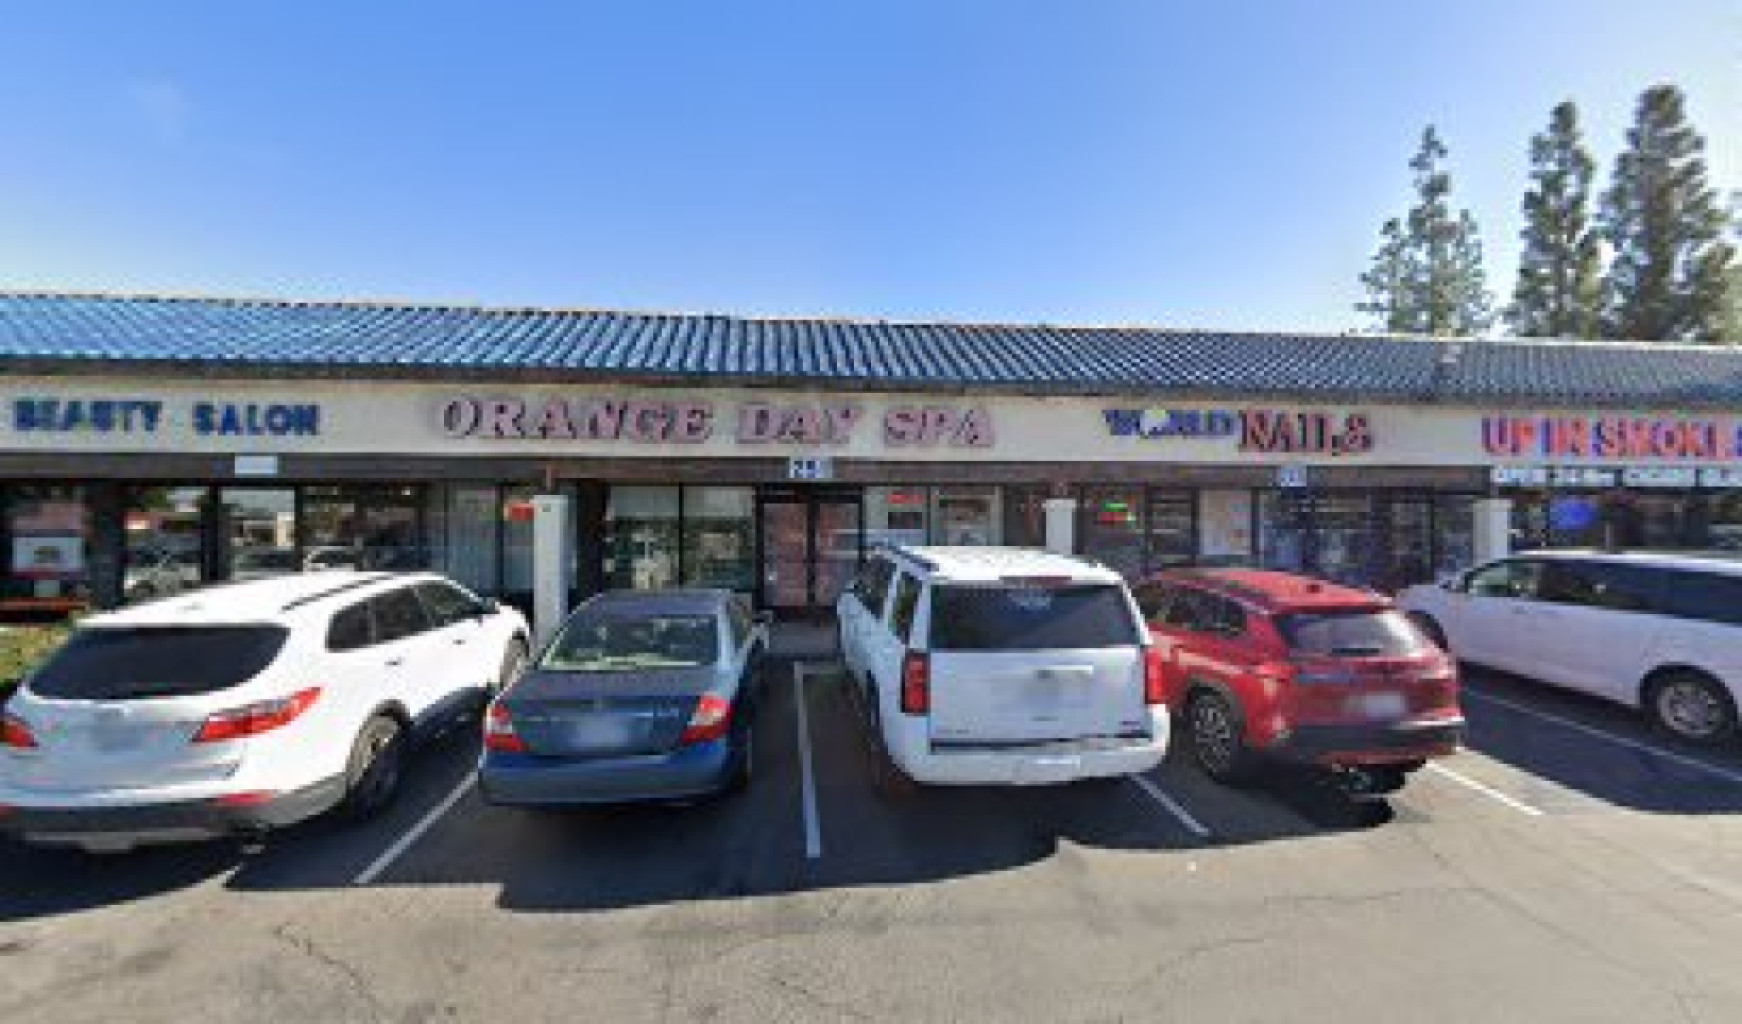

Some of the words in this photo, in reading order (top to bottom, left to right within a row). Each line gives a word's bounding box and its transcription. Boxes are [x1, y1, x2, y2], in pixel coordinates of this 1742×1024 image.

[14, 398, 162, 431] BEAUTY
[193, 404, 320, 436] SALON
[442, 397, 713, 443] ORANGE
[736, 402, 862, 444] DAY
[884, 406, 994, 447] SPA
[1238, 409, 1373, 454] NAILS
[1481, 417, 1535, 455] UP
[1540, 418, 1589, 456] IN
